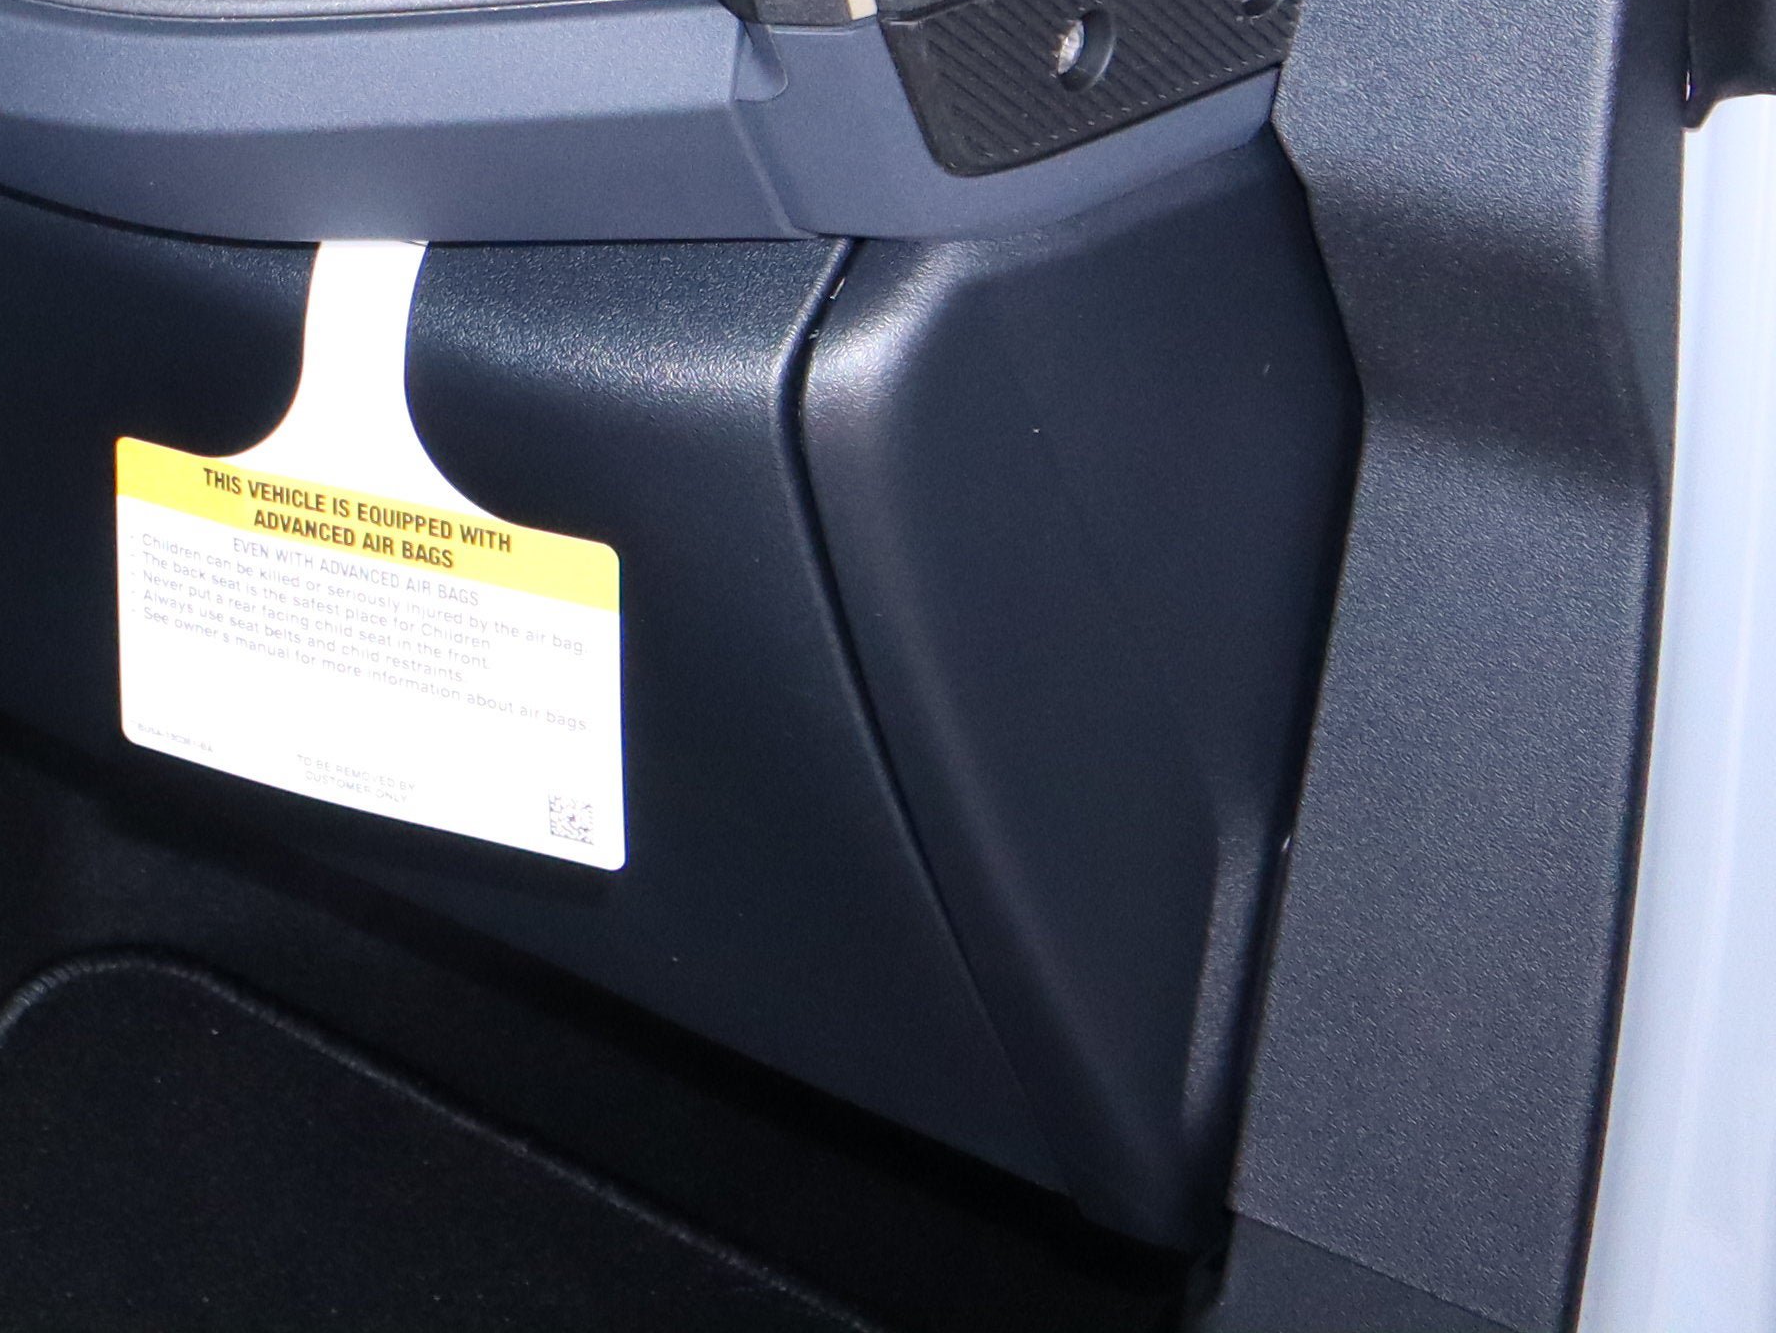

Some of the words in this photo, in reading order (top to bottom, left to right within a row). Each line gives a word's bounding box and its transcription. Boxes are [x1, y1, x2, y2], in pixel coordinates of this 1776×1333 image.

[203, 466, 241, 496] THIS
[247, 476, 326, 515] VEHICLE
[332, 495, 350, 519] IS
[356, 498, 452, 544] EQUIPPED
[459, 522, 512, 555] WITH
[253, 505, 355, 550] ADVANCED
[361, 529, 395, 557] AIR
[402, 538, 454, 571] BAGS
[142, 531, 201, 561] Children
[206, 553, 231, 571] can
[236, 561, 253, 577] be
[259, 566, 300, 588] killed
[305, 579, 321, 593] or
[326, 581, 400, 614] seriously
[405, 599, 462, 629] injured
[469, 615, 488, 634] by
[494, 619, 519, 638] the
[525, 628, 546, 645] air
[142, 550, 168, 570] The
[173, 561, 206, 581] back
[211, 573, 241, 591] seat
[245, 582, 257, 597] is
[263, 587, 286, 604] the
[292, 593, 340, 617] safest
[344, 604, 387, 631] place
[393, 616, 414, 633] for
[232, 536, 269, 560] EVEN
[275, 546, 313, 570] WITH
[319, 555, 399, 590] ADVANCED
[405, 575, 431, 596] AIR
[437, 582, 479, 608] BAGS
[142, 569, 183, 592] Never
[187, 583, 211, 602] put
[216, 593, 223, 605] a
[228, 596, 256, 615] rear
[261, 604, 309, 631] facing
[314, 617, 353, 638] child
[358, 627, 391, 648] seat
[397, 637, 411, 652] in
[416, 641, 442, 659] the
[143, 587, 194, 616] Always
[198, 606, 224, 623] use
[229, 615, 258, 633] seat
[264, 623, 301, 644] belts
[306, 634, 336, 653] and
[341, 642, 379, 663] child
[143, 605, 169, 624] See
[174, 617, 230, 644] owners
[234, 634, 289, 660] manual
[294, 648, 316, 666] for
[321, 658, 362, 678] more
[367, 666, 460, 701] information
[466, 689, 513, 714] about
[519, 704, 539, 720] air
[296, 752, 312, 767] TO
[316, 758, 330, 772] BE
[335, 763, 395, 788] REMOVED
[399, 779, 416, 793] BY
[304, 769, 370, 795] CUSTOMER
